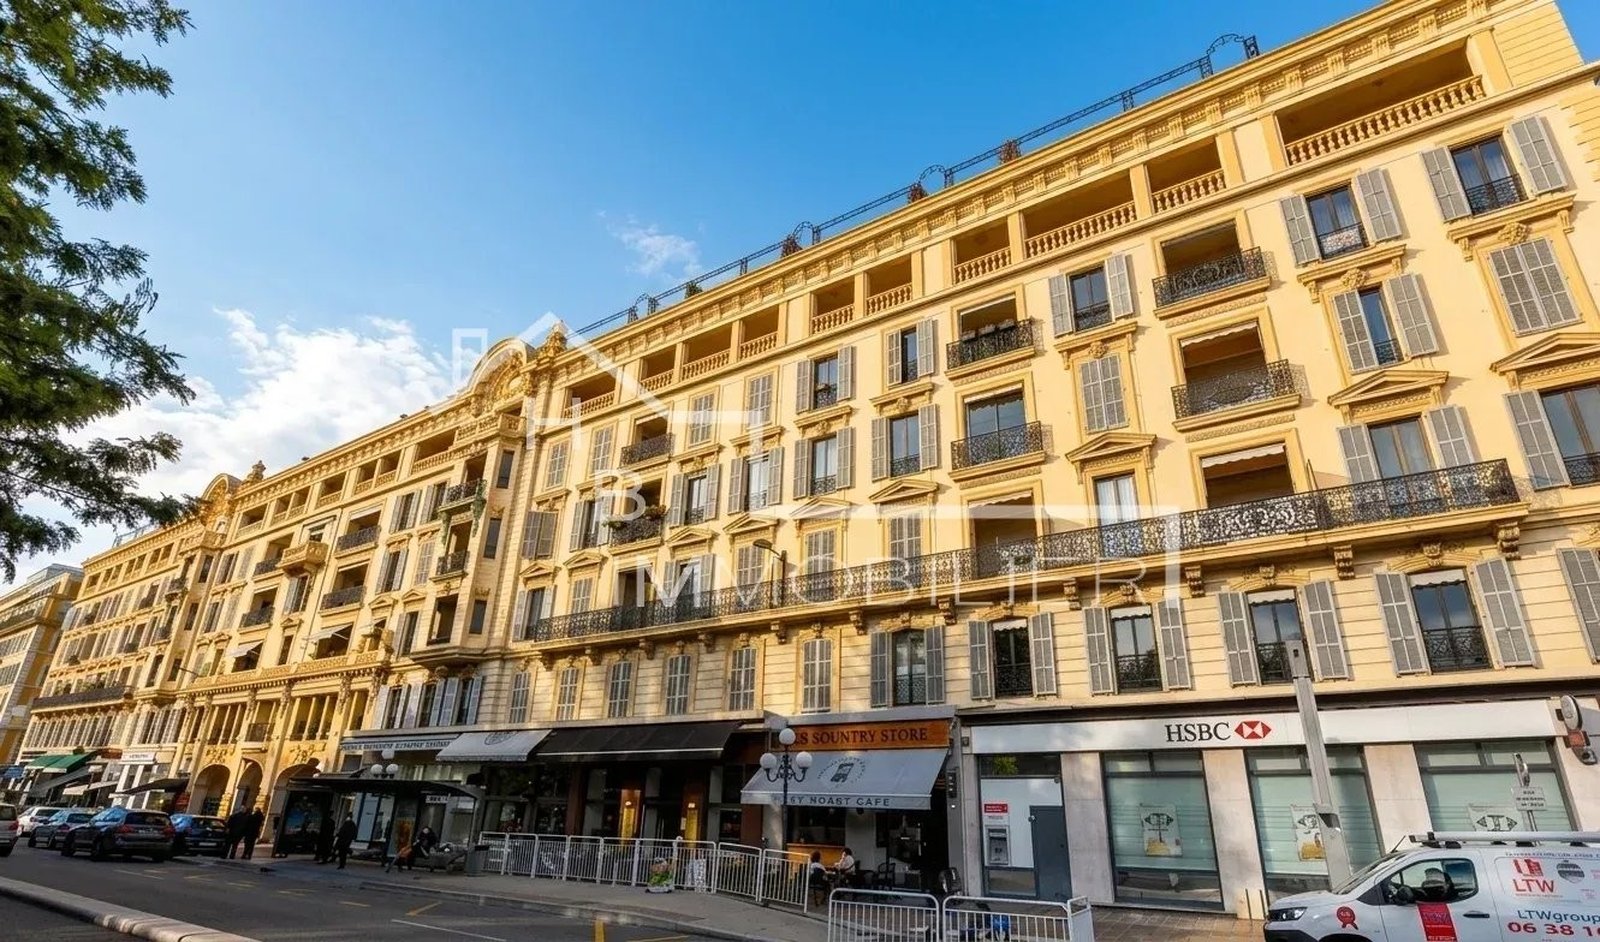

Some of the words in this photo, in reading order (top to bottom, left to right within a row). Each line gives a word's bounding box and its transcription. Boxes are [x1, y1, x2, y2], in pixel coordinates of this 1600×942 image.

[812, 730, 877, 745] SOUNTRY
[881, 727, 928, 743] STORE
[1165, 722, 1231, 742] HSBC
[1513, 879, 1554, 893] LTW
[1517, 910, 1600, 924] LTWgroup
[1508, 922, 1537, 934] 06
[1544, 924, 1574, 936] 38
[1582, 926, 1600, 937] 1
